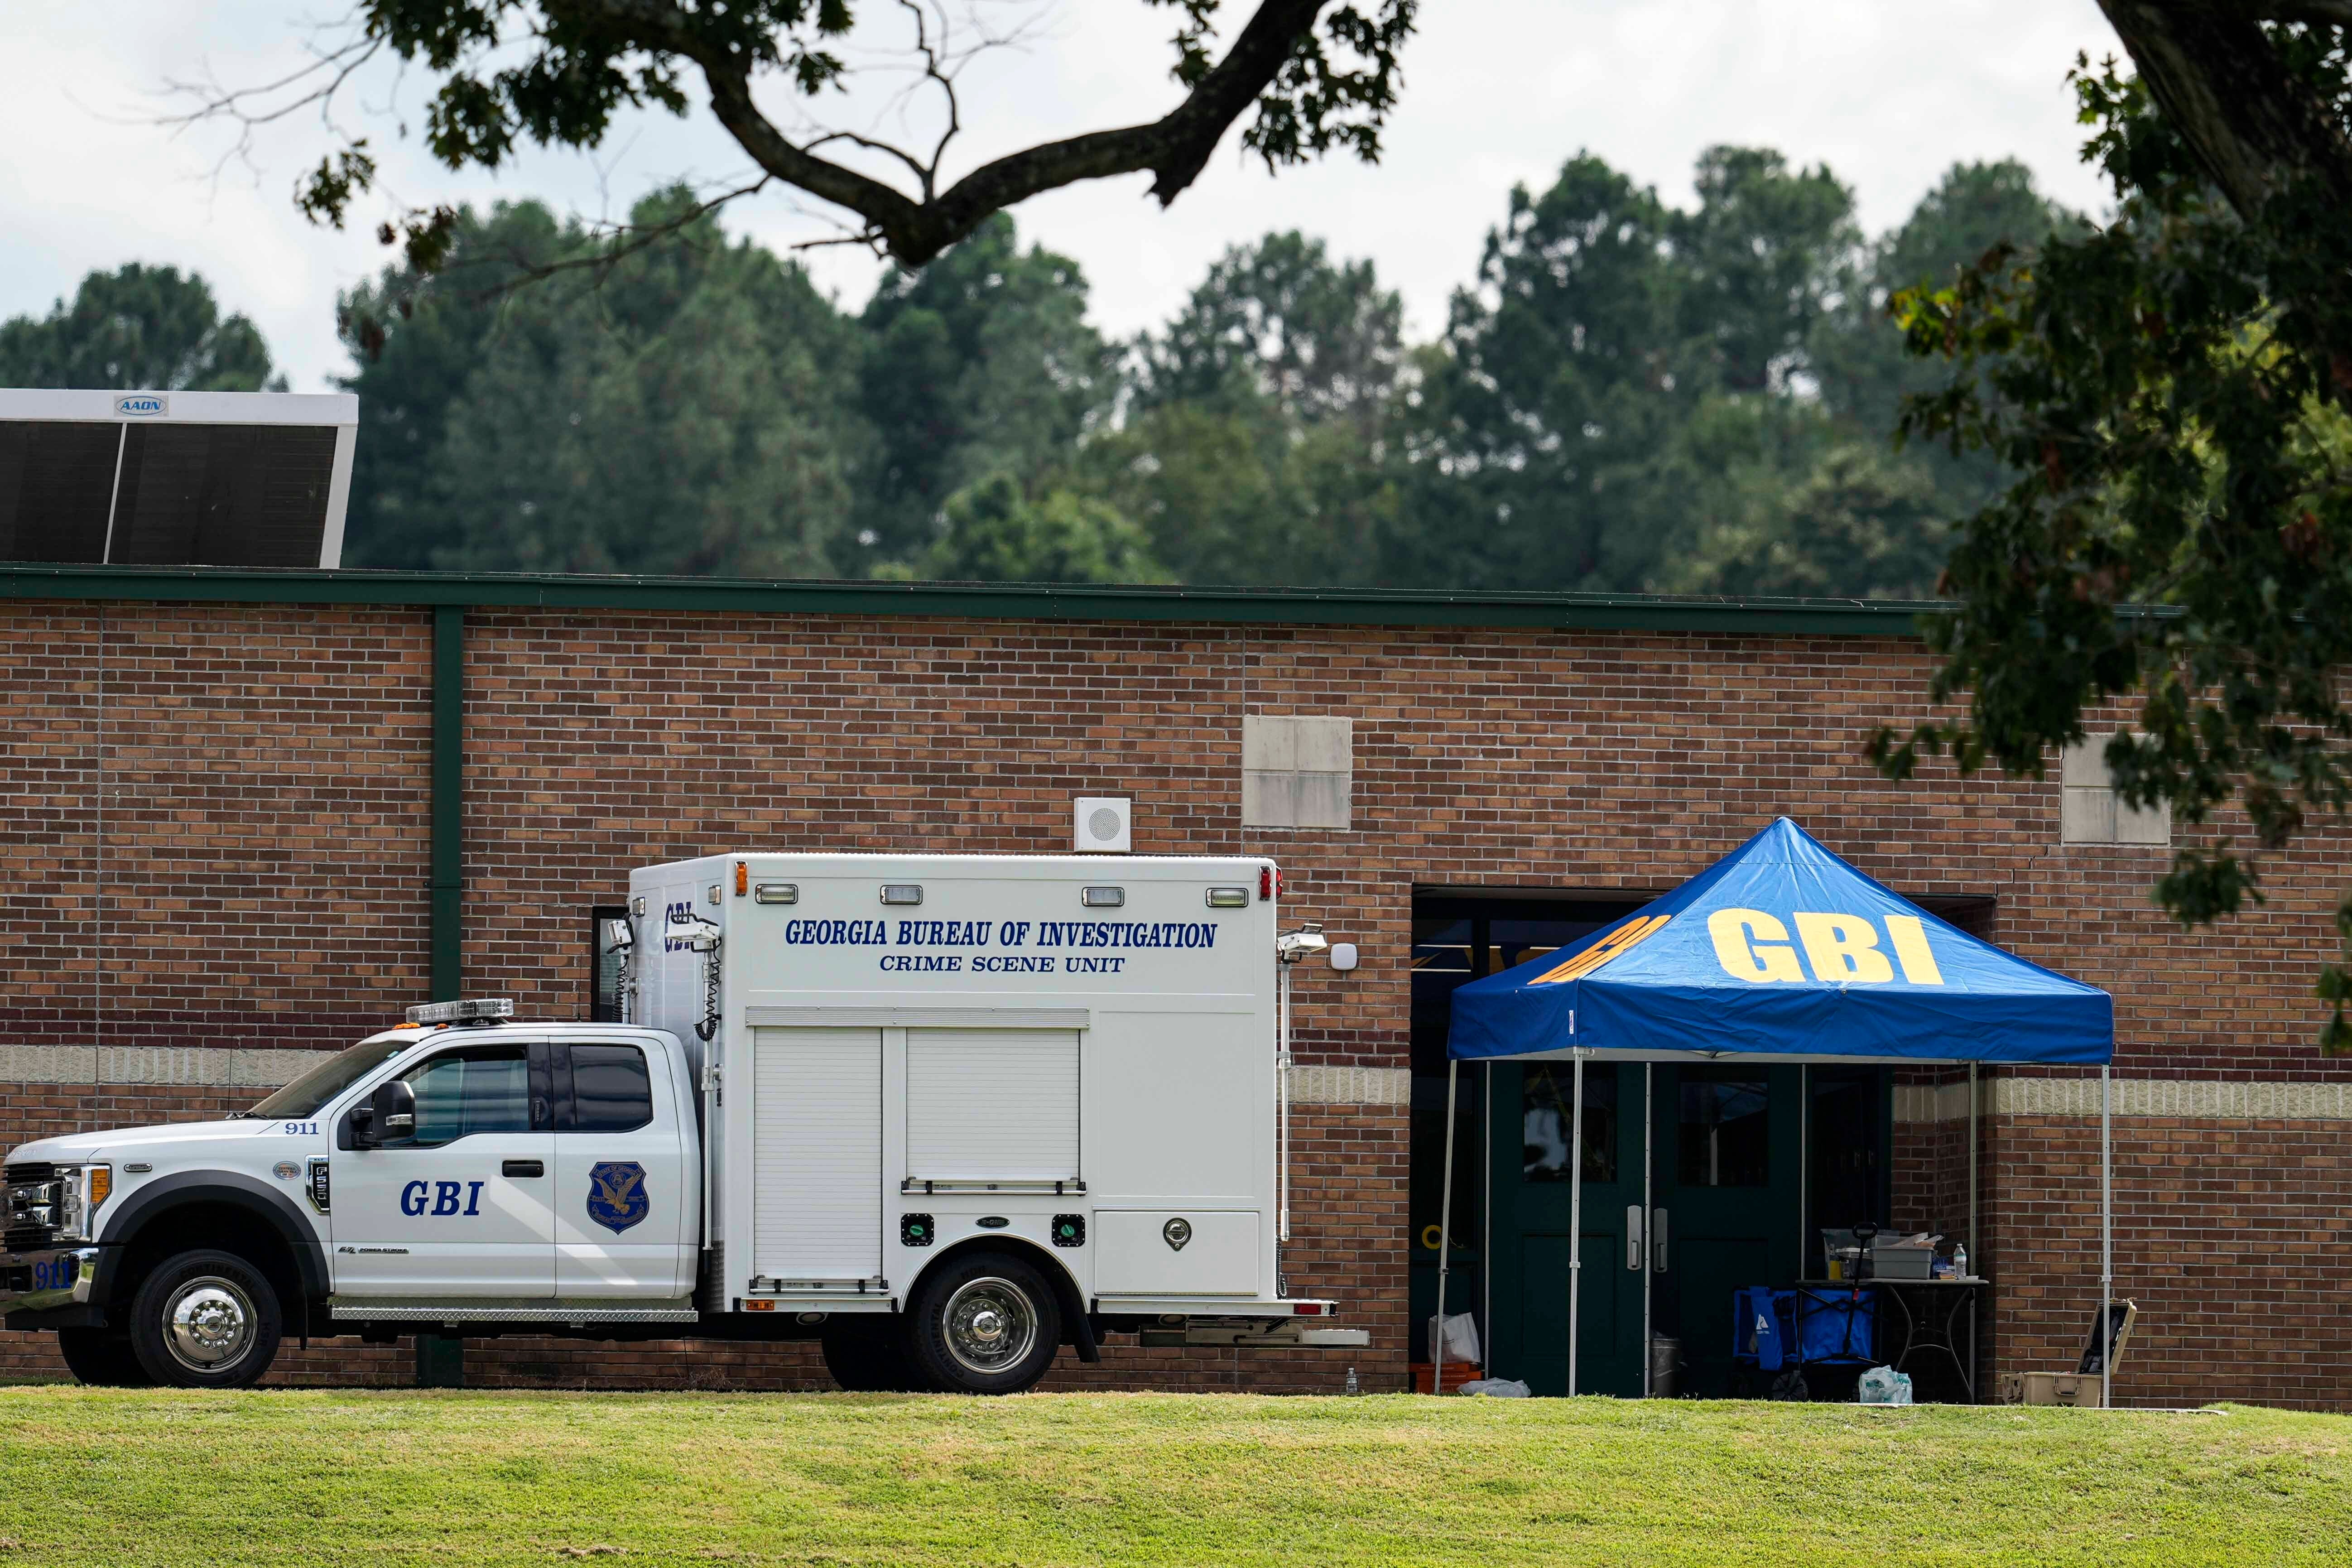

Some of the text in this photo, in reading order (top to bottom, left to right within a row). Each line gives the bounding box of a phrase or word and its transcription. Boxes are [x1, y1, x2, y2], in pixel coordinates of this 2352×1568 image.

[120, 401, 161, 410] AAON
[786, 919, 1217, 948] GEORGIA BUREAU OF INVESTIGATION
[1707, 908, 1944, 986] GBI
[880, 956, 1125, 972] CRIME SCENE UNIT
[1527, 914, 1671, 985] GB
[285, 1122, 319, 1135] 911
[400, 1180, 485, 1216] GBI
[36, 1260, 72, 1290] 911
